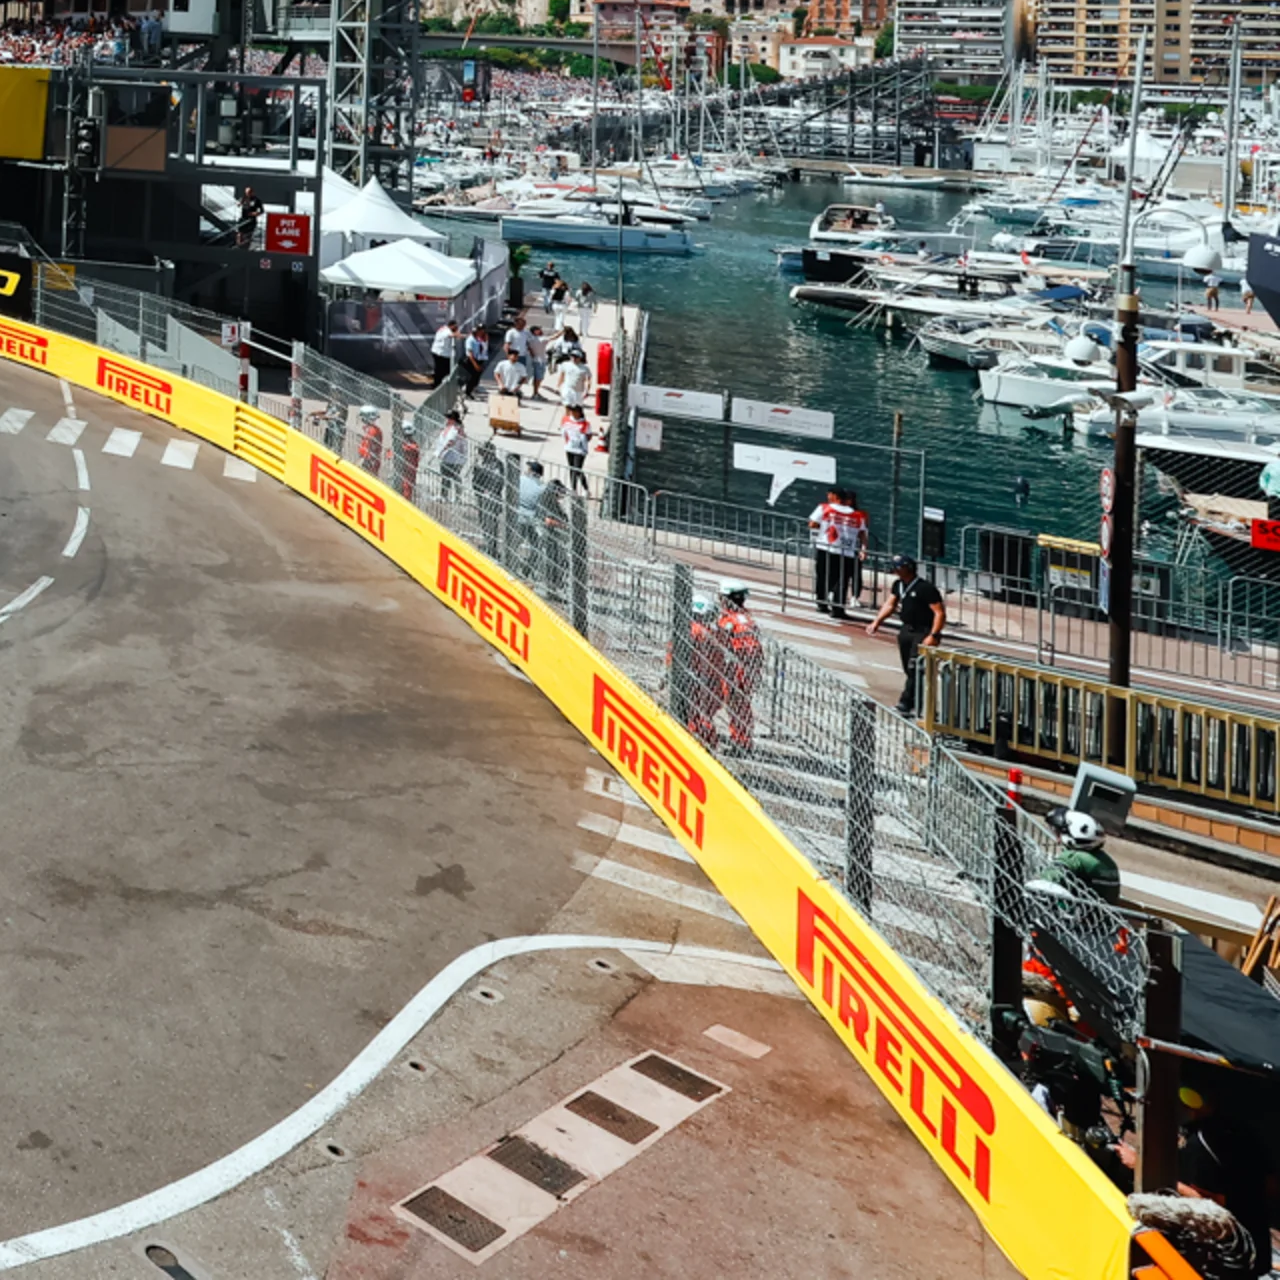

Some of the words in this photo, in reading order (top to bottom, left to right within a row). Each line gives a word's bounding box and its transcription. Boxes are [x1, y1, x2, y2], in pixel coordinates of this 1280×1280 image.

[275, 227, 301, 237] LANE
[280, 219, 296, 228] PIT
[96, 356, 173, 416] PIRELLI
[310, 453, 386, 542] PIRELLI
[437, 542, 531, 663] PIRELLI
[591, 673, 707, 851] PIRELLI
[796, 887, 997, 1205] PIRELLI
